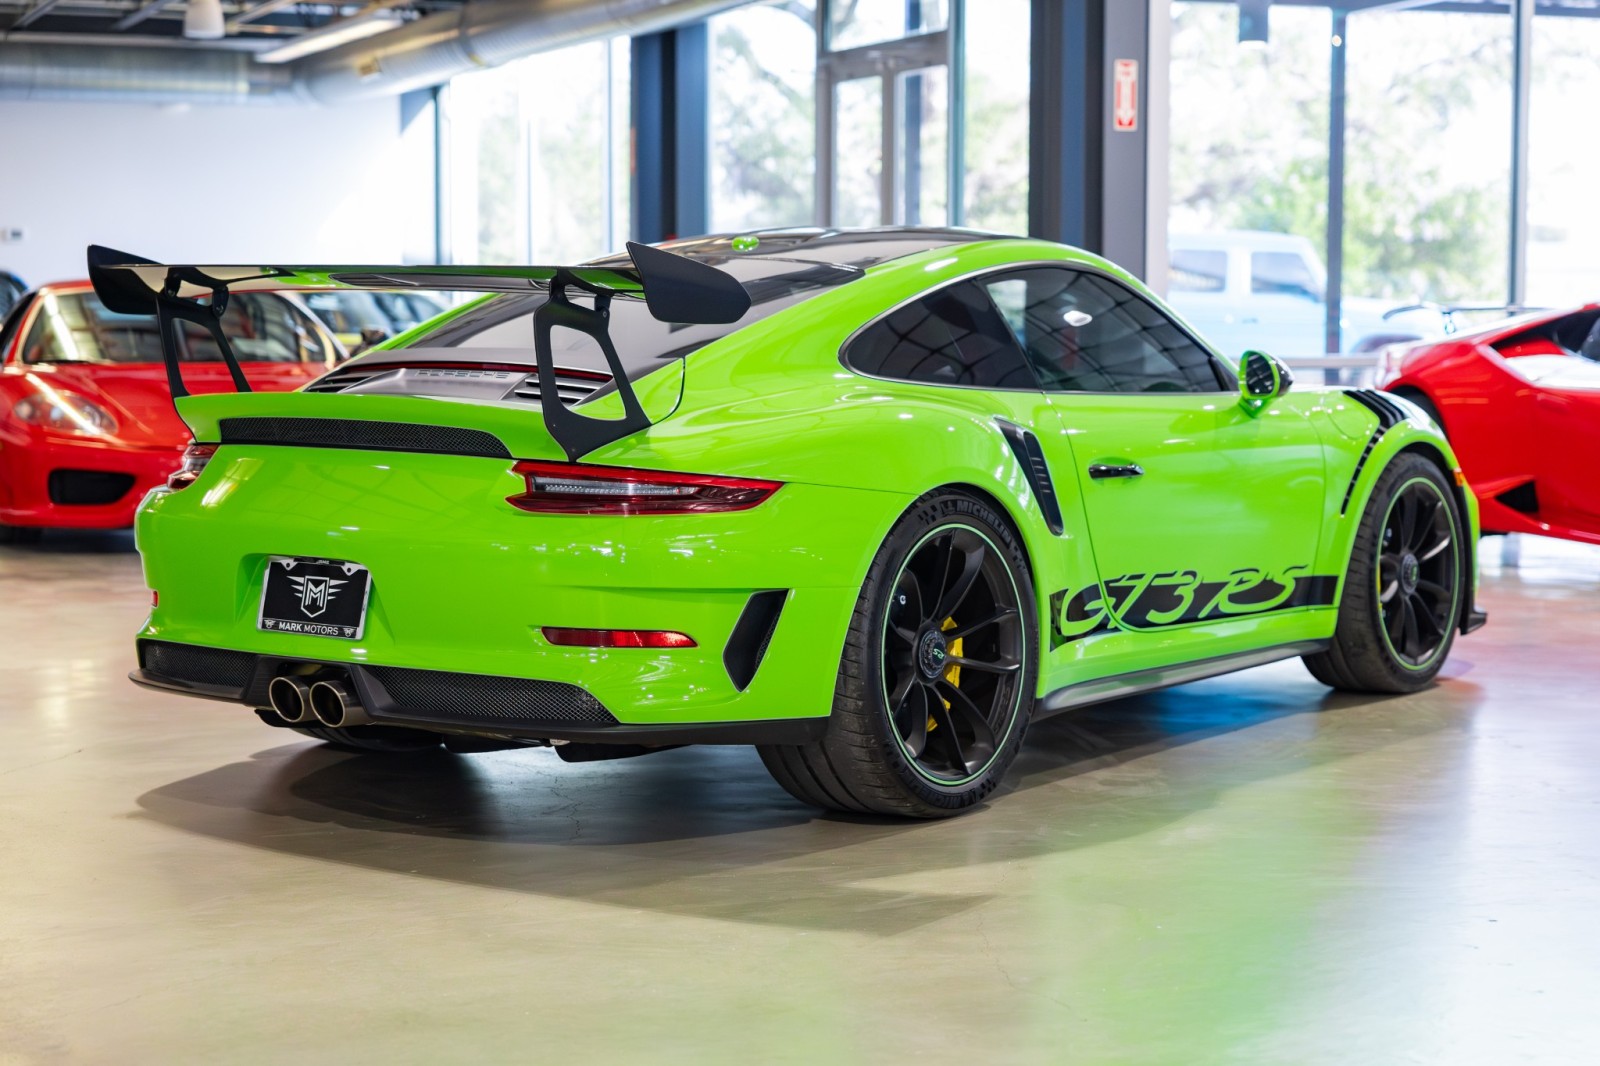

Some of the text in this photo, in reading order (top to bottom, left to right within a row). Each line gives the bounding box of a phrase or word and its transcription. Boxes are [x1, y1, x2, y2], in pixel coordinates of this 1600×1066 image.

[417, 369, 510, 379] PORSCHE
[956, 499, 1013, 545] MICHELIN
[1060, 564, 1308, 637] GT3 RS
[279, 622, 339, 635] MARK MOTORS
